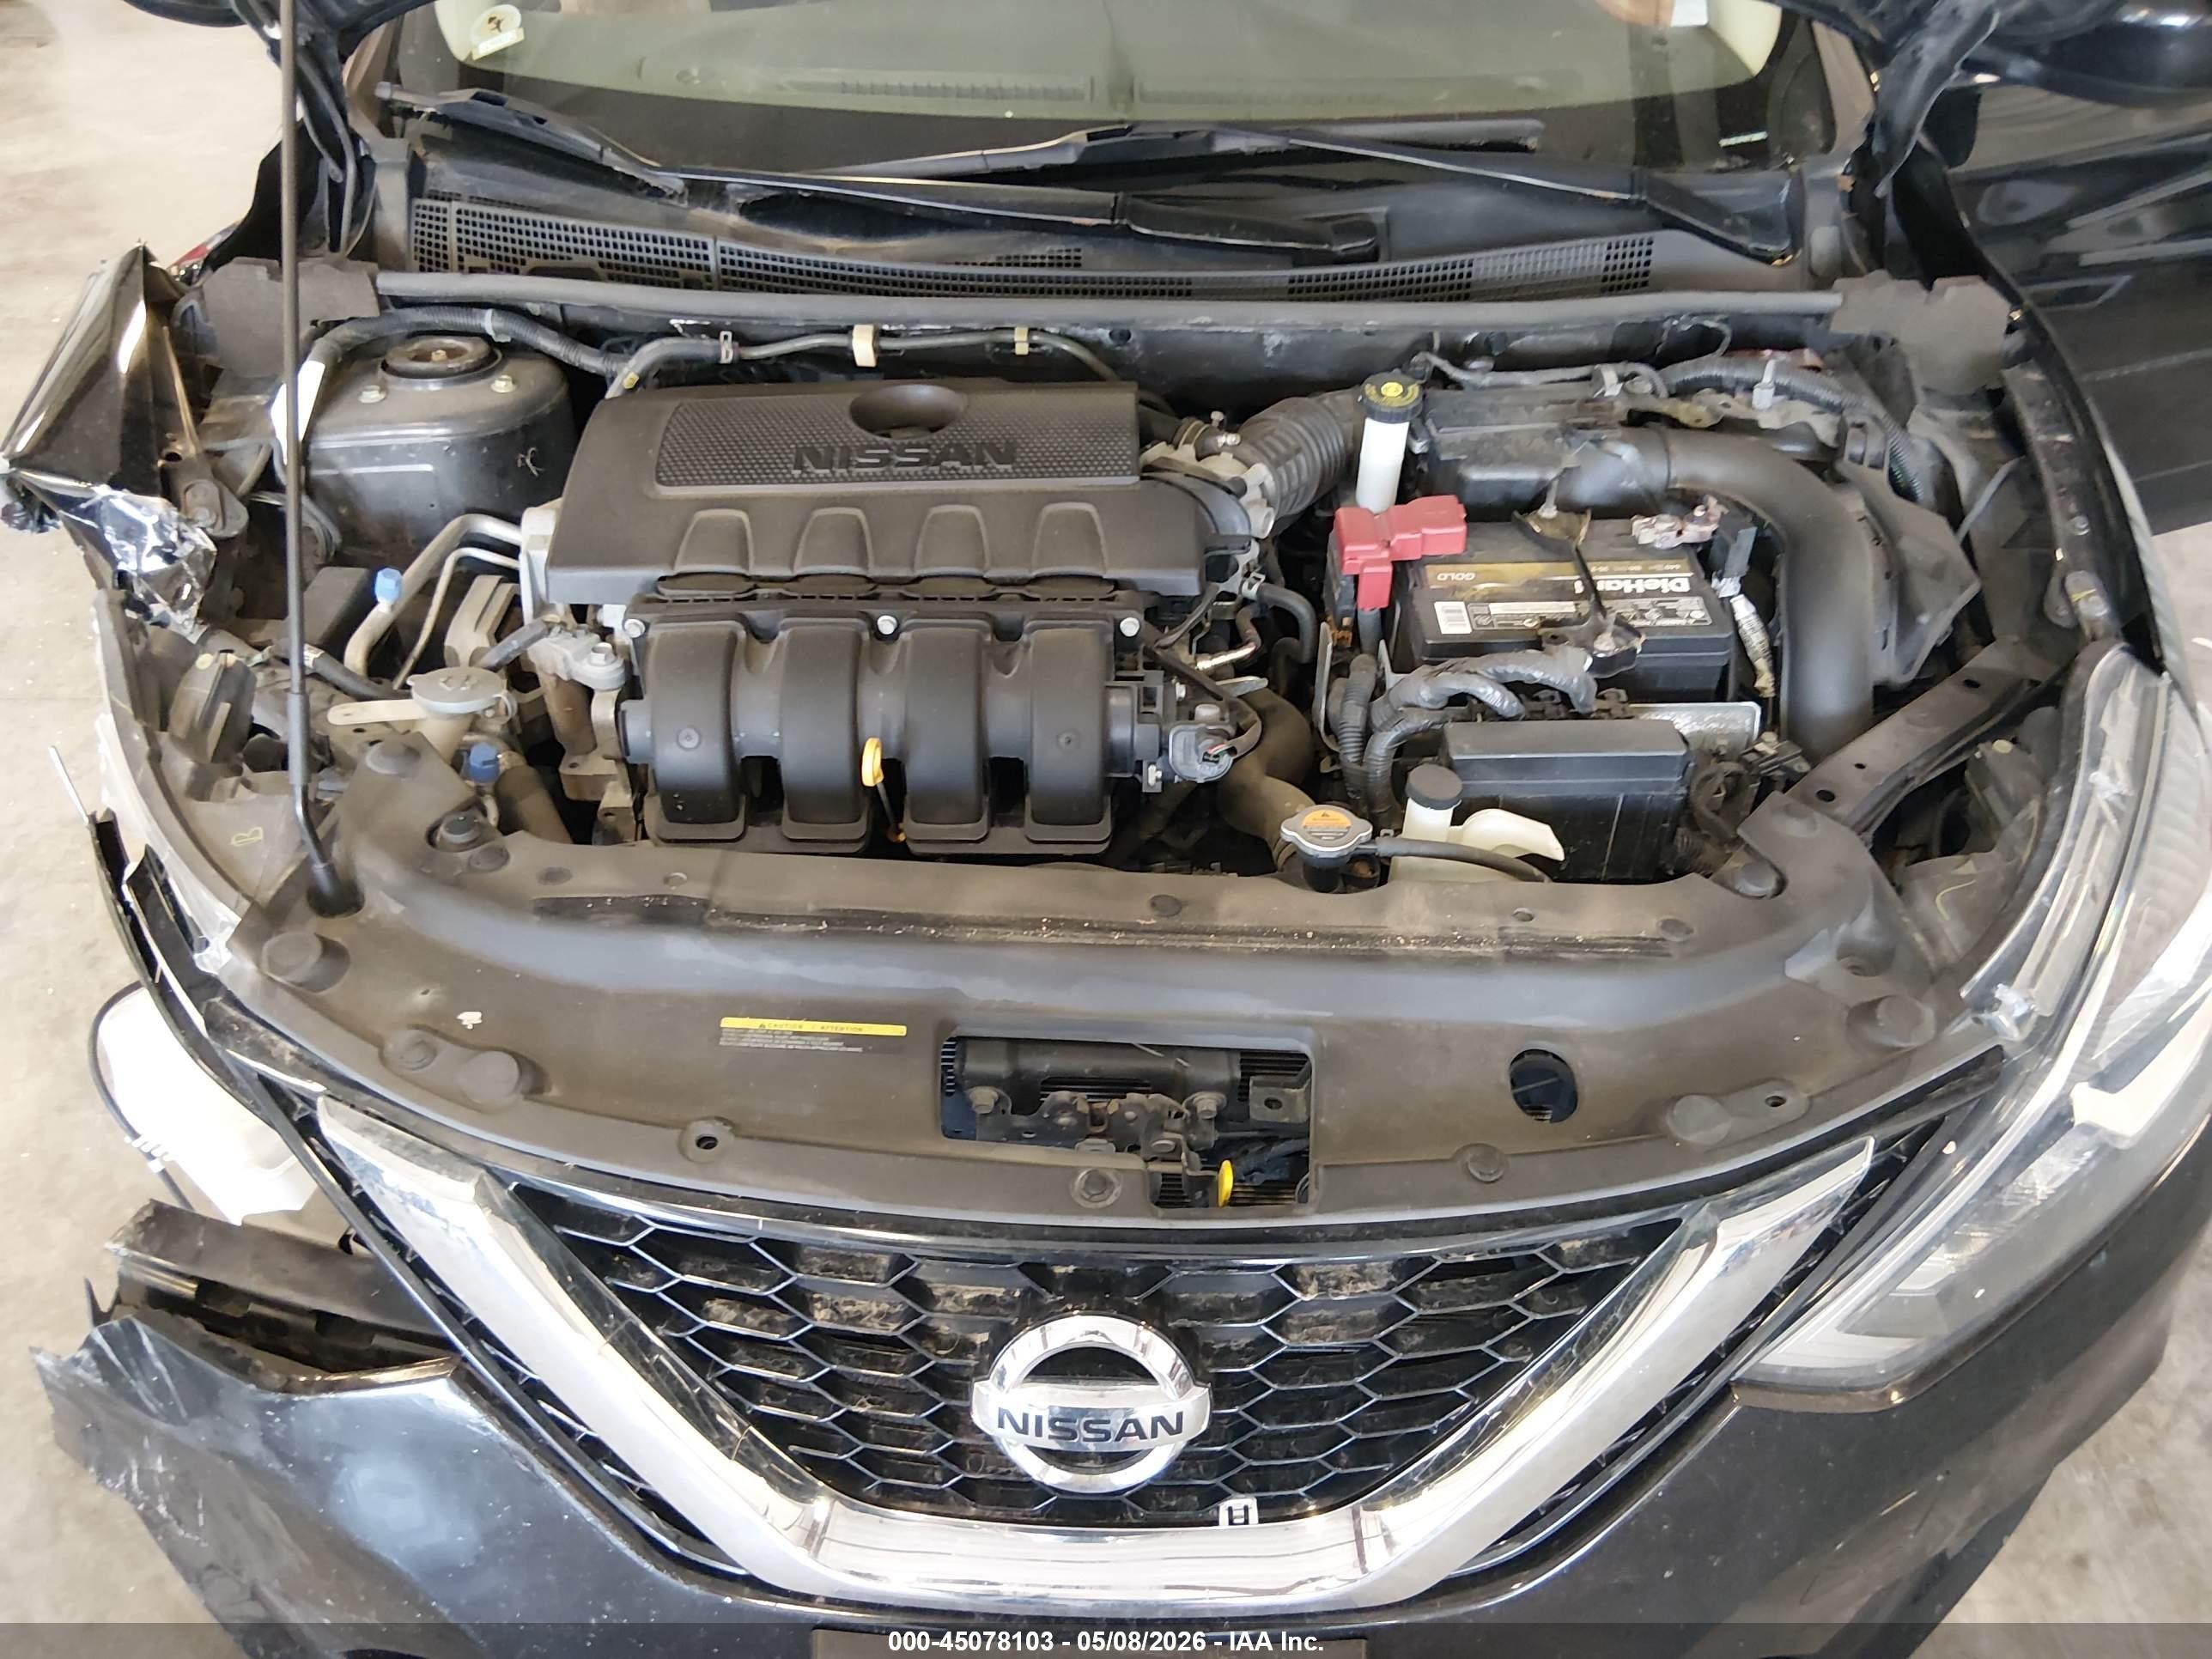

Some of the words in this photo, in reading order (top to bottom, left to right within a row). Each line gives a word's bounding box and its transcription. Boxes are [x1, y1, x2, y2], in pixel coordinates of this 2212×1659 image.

[791, 443, 1014, 474] NISSAN
[1437, 572, 1476, 581] GOLD
[997, 1407, 1183, 1443] NISSAN
